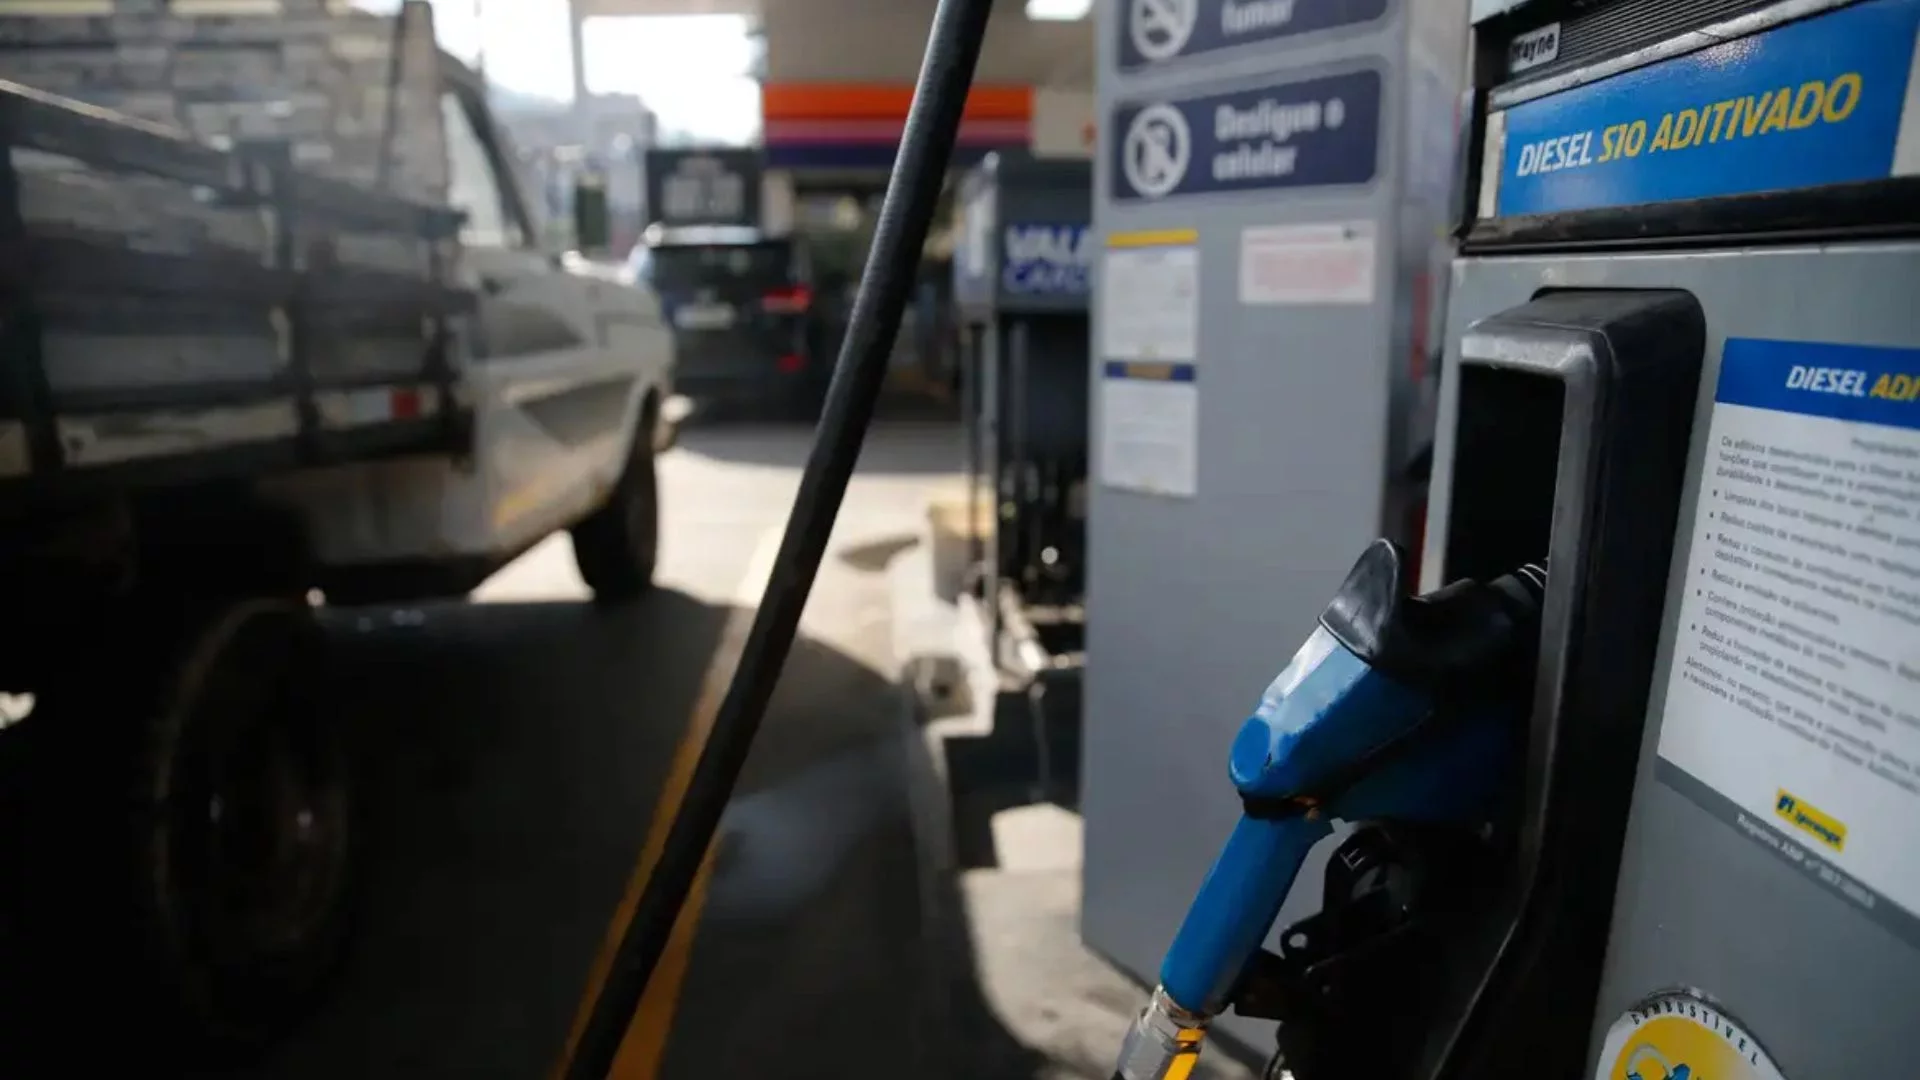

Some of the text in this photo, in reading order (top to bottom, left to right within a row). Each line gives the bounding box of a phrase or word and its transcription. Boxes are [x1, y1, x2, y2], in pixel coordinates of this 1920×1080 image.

[1215, 97, 1345, 142] Desligue o
[1517, 71, 1862, 176] DIESEL S10 ADITIVADO
[1212, 140, 1297, 181] celular
[1786, 365, 1867, 398] DIESEL
